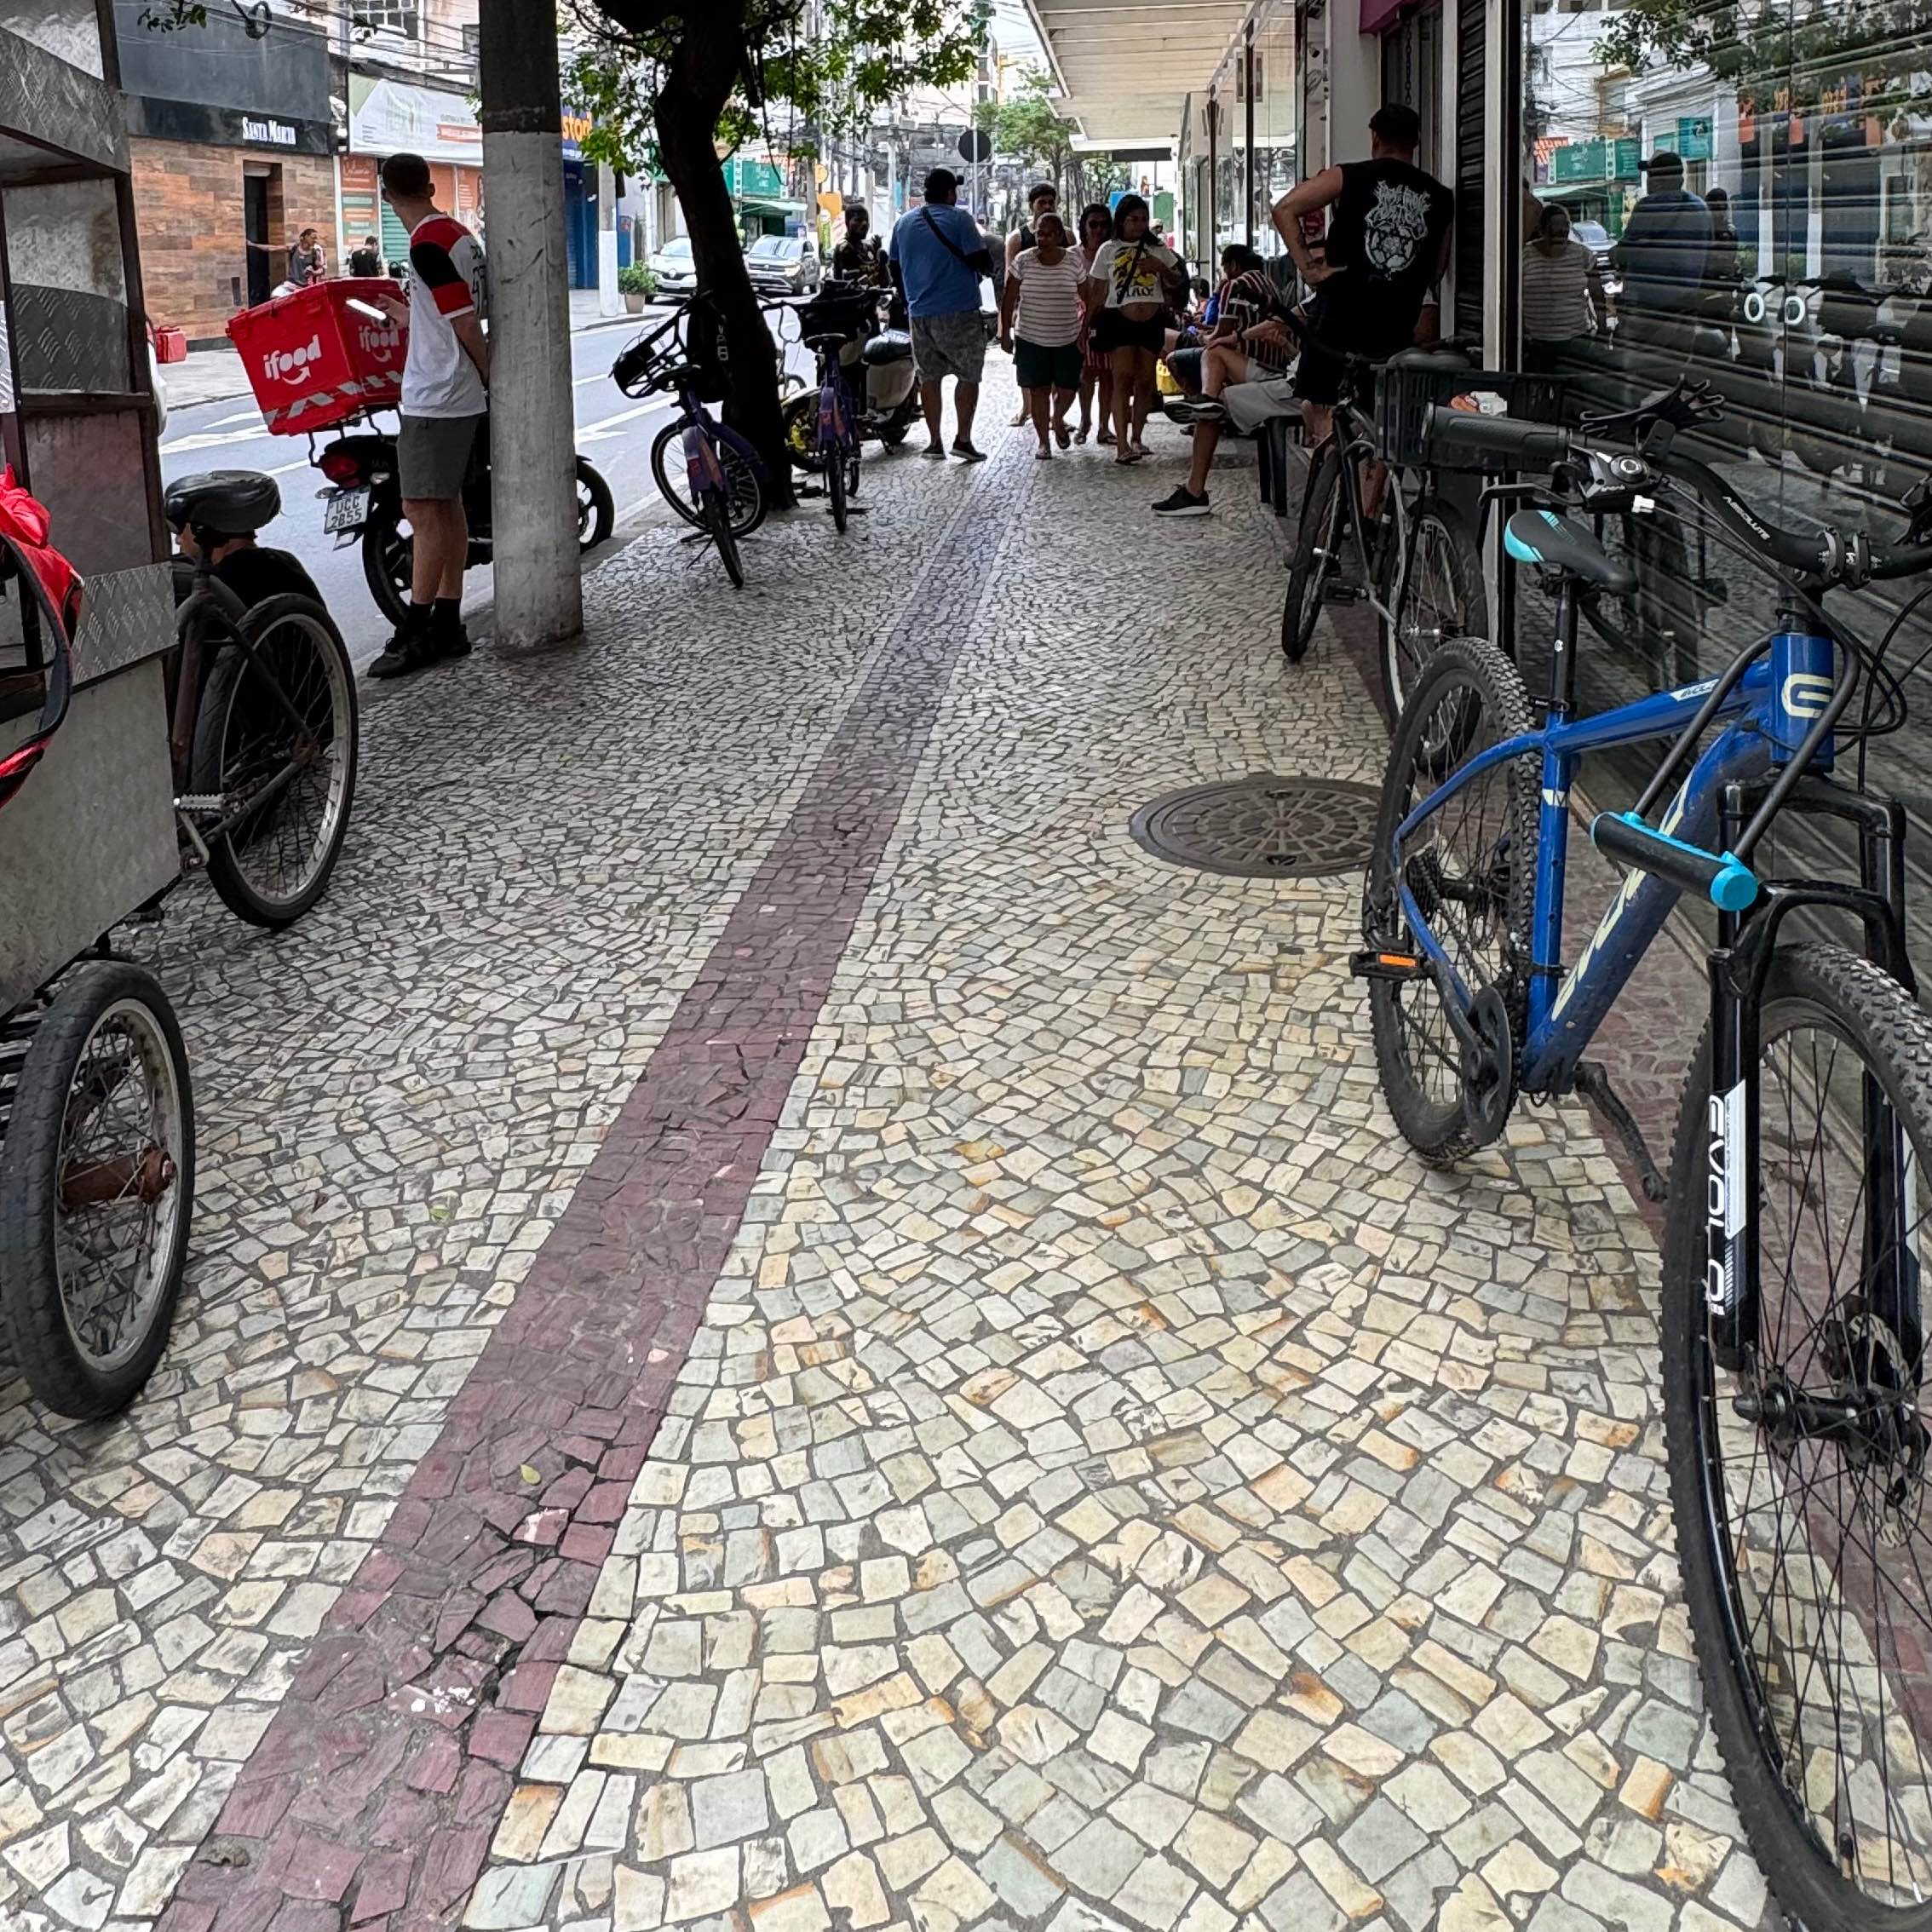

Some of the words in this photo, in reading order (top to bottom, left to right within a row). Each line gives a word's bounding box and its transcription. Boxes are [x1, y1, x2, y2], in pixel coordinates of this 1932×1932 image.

[262, 333, 322, 381] ifood
[358, 323, 400, 353] ifood
[1722, 496, 1771, 541] ABSOLUTE
